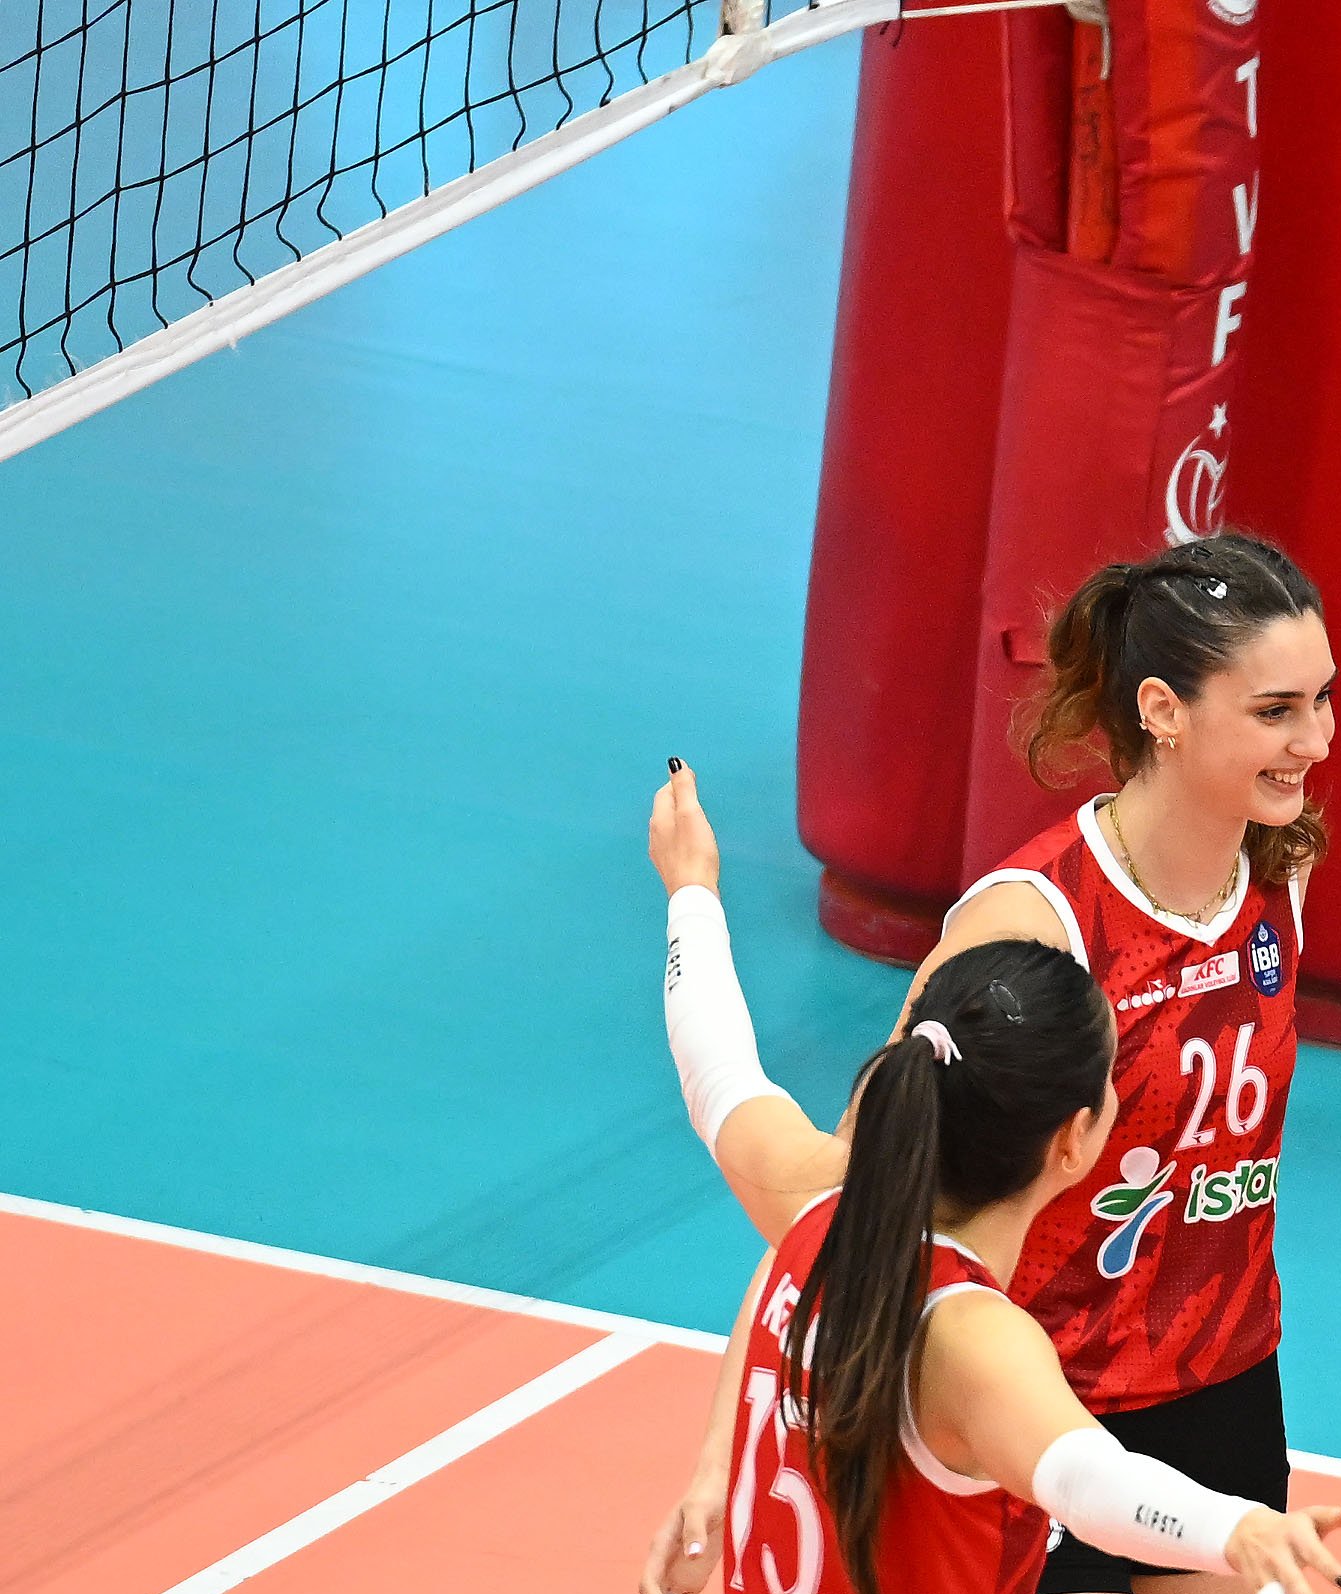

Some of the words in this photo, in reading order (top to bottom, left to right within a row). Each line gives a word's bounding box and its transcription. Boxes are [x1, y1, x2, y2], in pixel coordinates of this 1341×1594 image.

[1193, 957, 1225, 982] KFC
[1173, 1021, 1269, 1152] 26
[1183, 1156, 1280, 1223] ista
